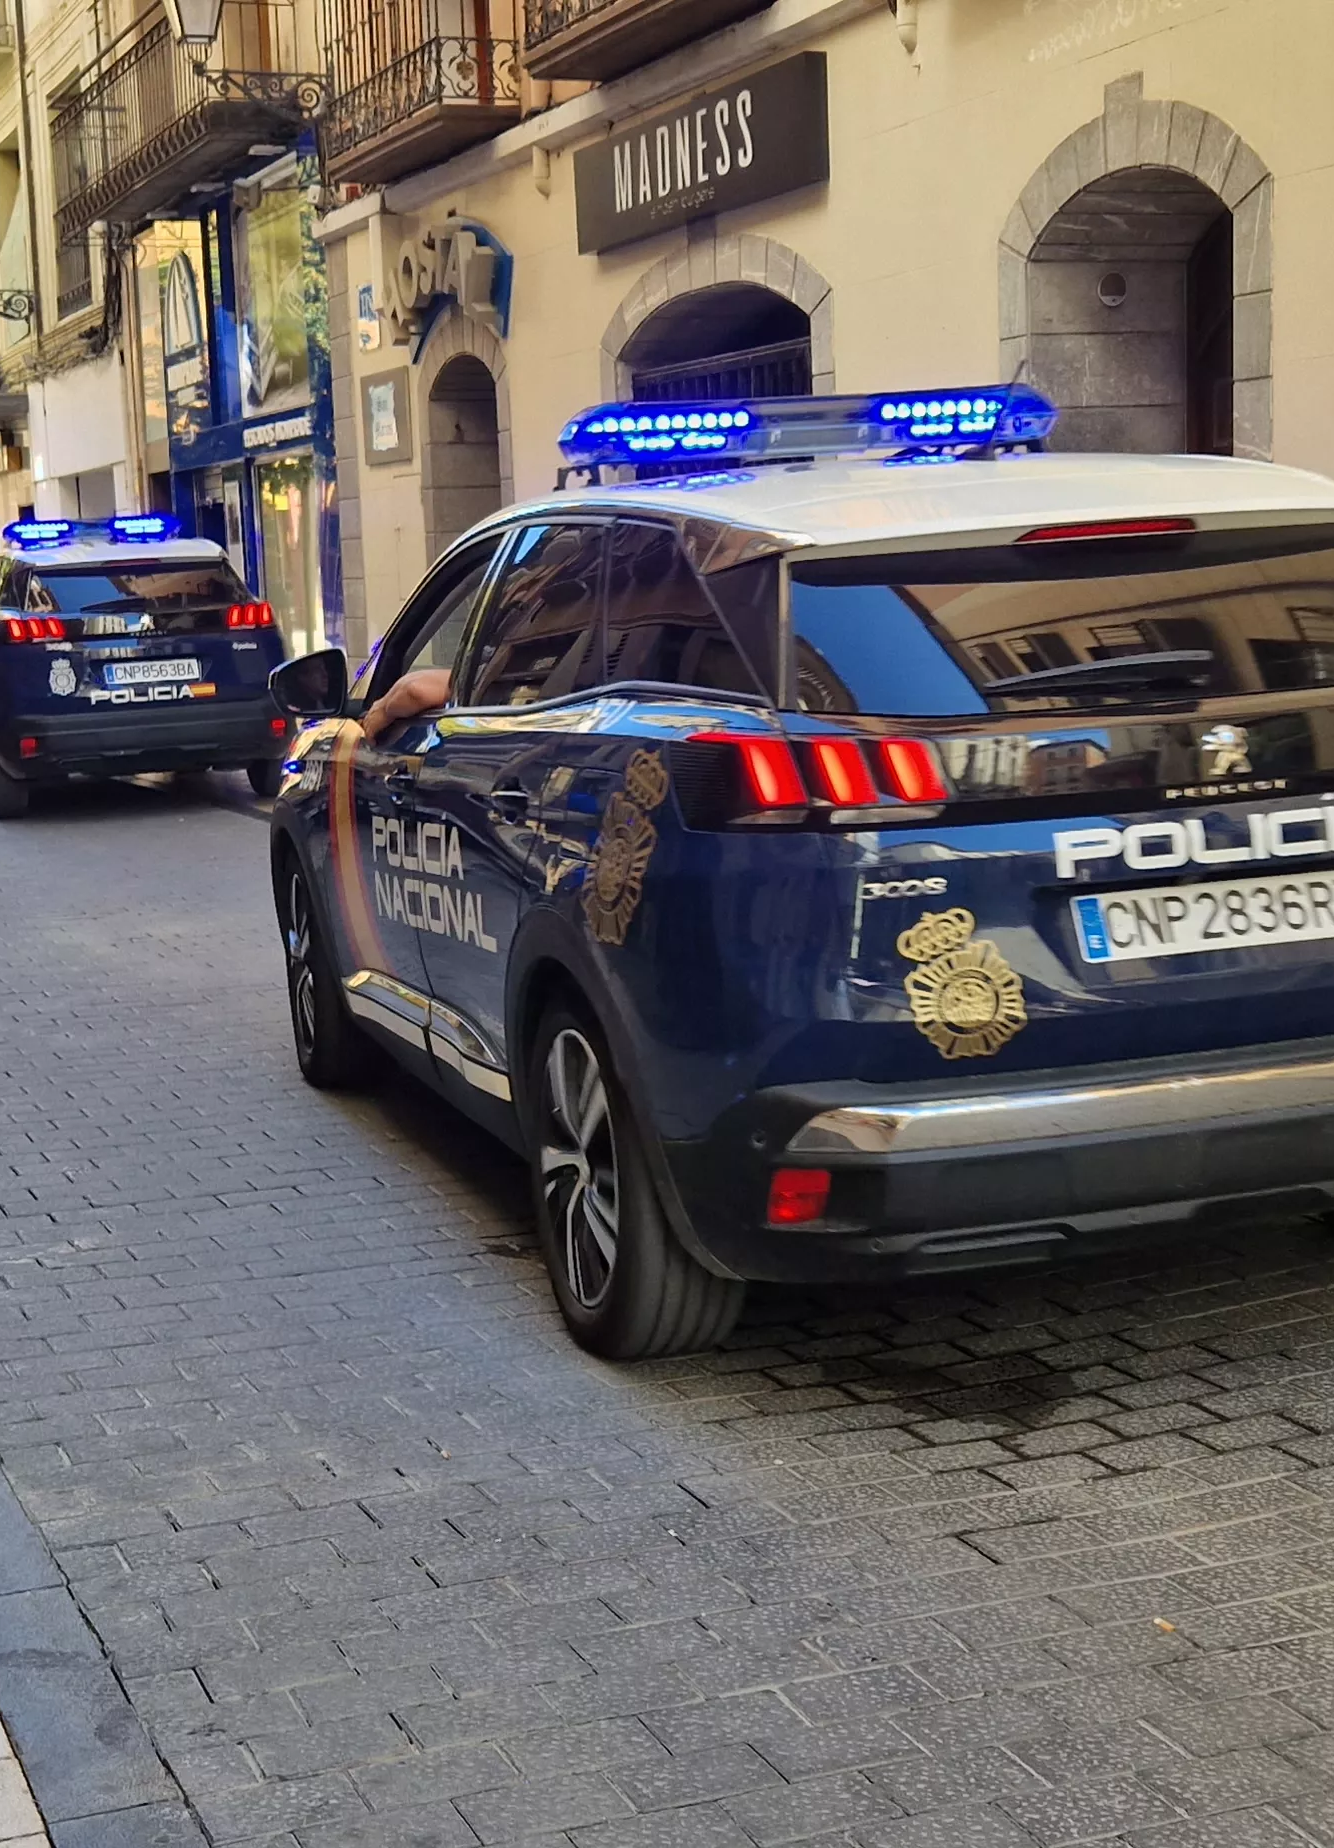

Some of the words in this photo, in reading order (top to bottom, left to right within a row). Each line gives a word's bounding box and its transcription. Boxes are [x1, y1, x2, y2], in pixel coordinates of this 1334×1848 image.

[613, 89, 754, 213] MADNESS
[114, 663, 196, 681] CNP8563BA
[374, 870, 498, 953] NACIONAL
